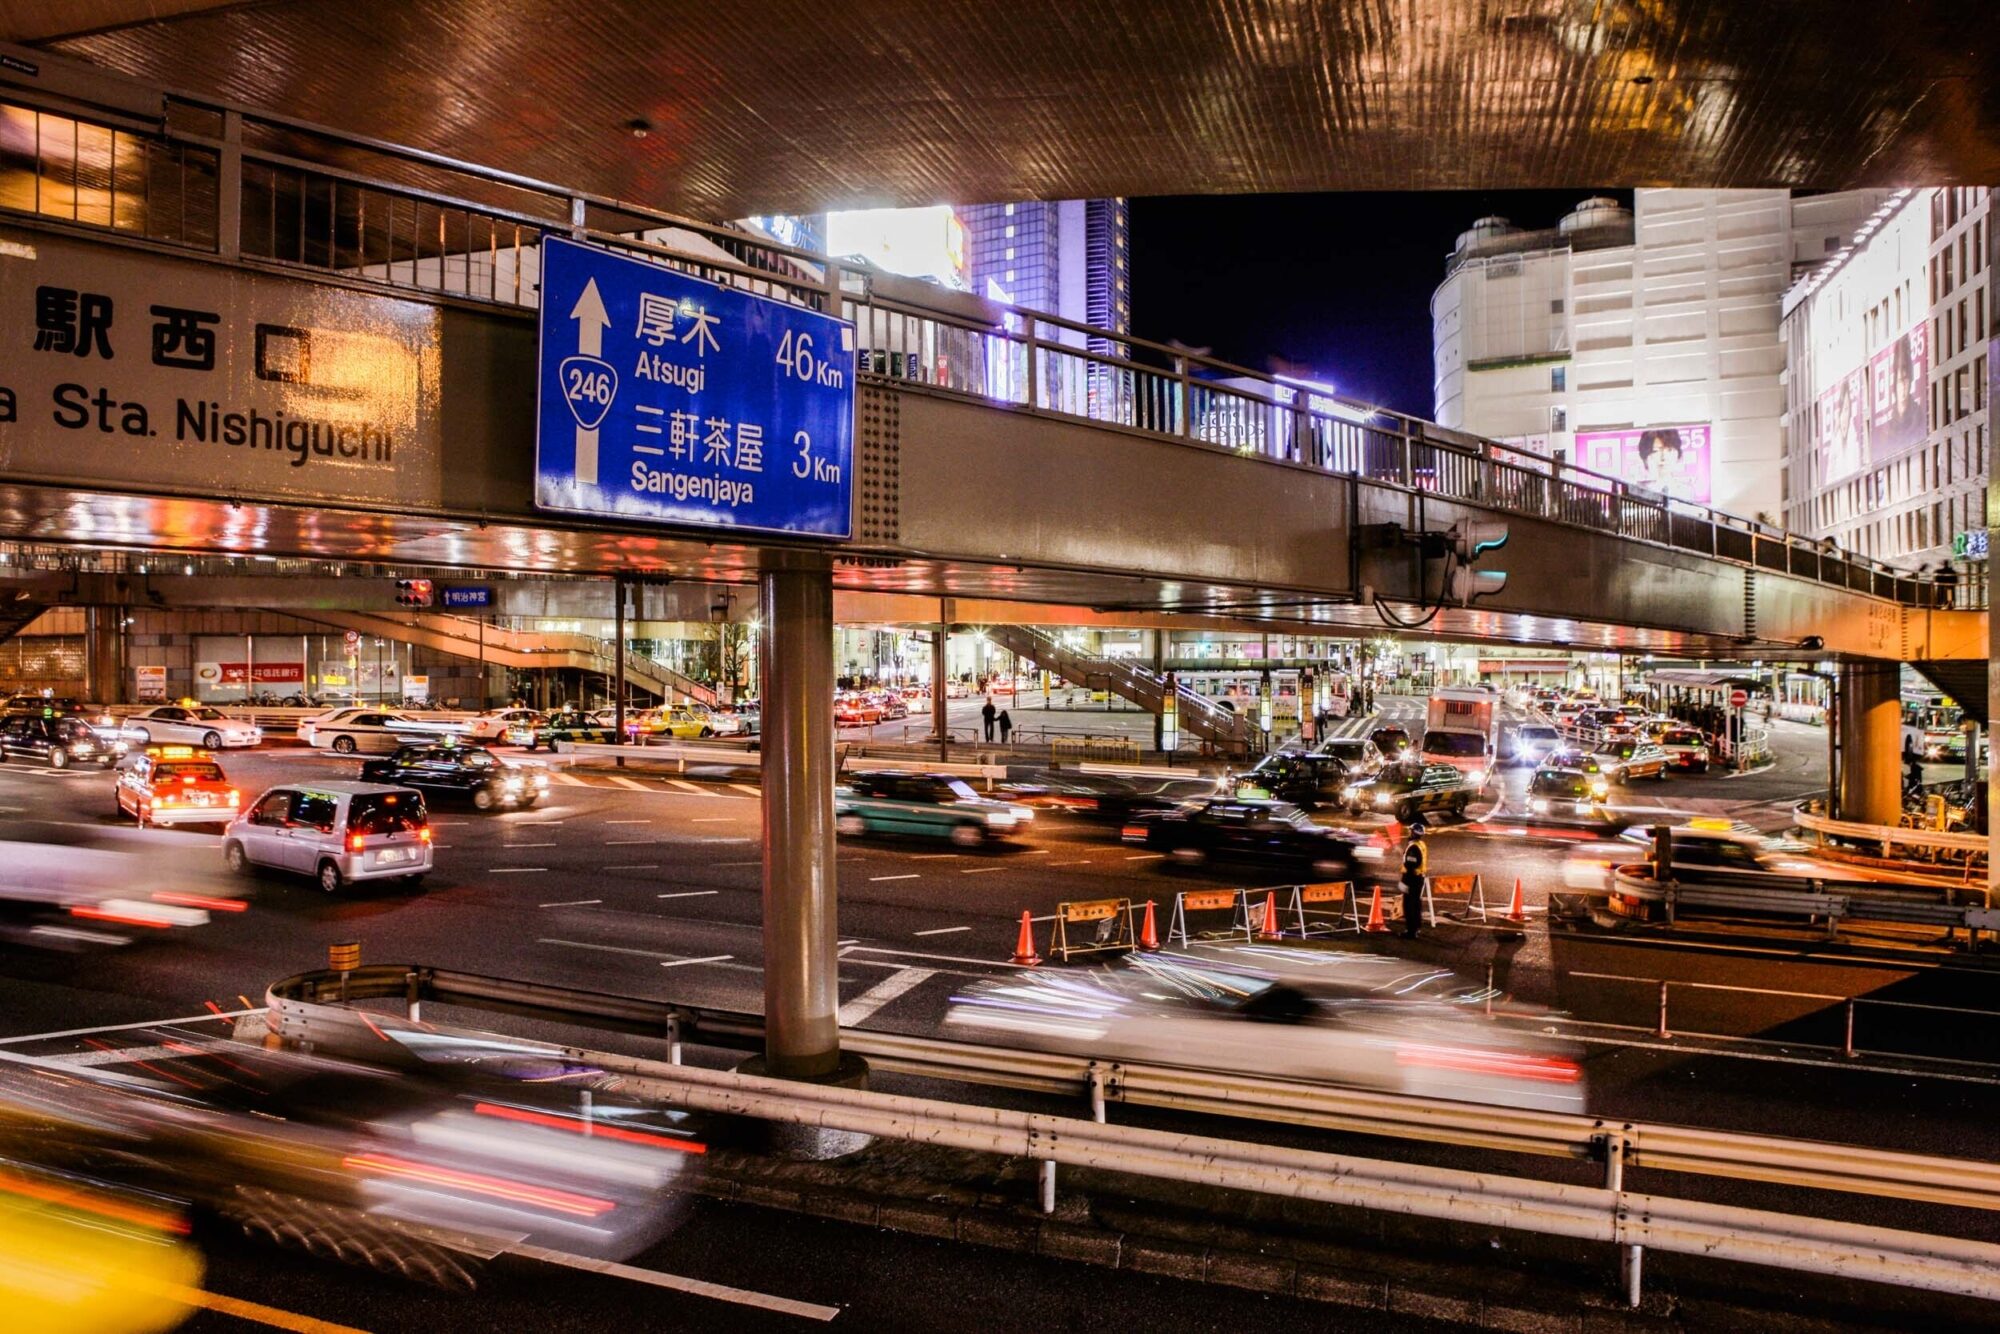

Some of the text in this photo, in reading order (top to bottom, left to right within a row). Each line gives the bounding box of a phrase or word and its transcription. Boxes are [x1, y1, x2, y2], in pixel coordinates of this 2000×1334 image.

[33, 285, 310, 384] 駅西口
[635, 292, 720, 357] 厚木
[569, 368, 610, 405] 246
[635, 351, 704, 394] Atsugi
[53, 383, 157, 436] Sta.
[176, 398, 392, 467] Nishiguchi
[632, 405, 763, 472] 三軒茶屋
[631, 461, 753, 507] Sangenjaya
